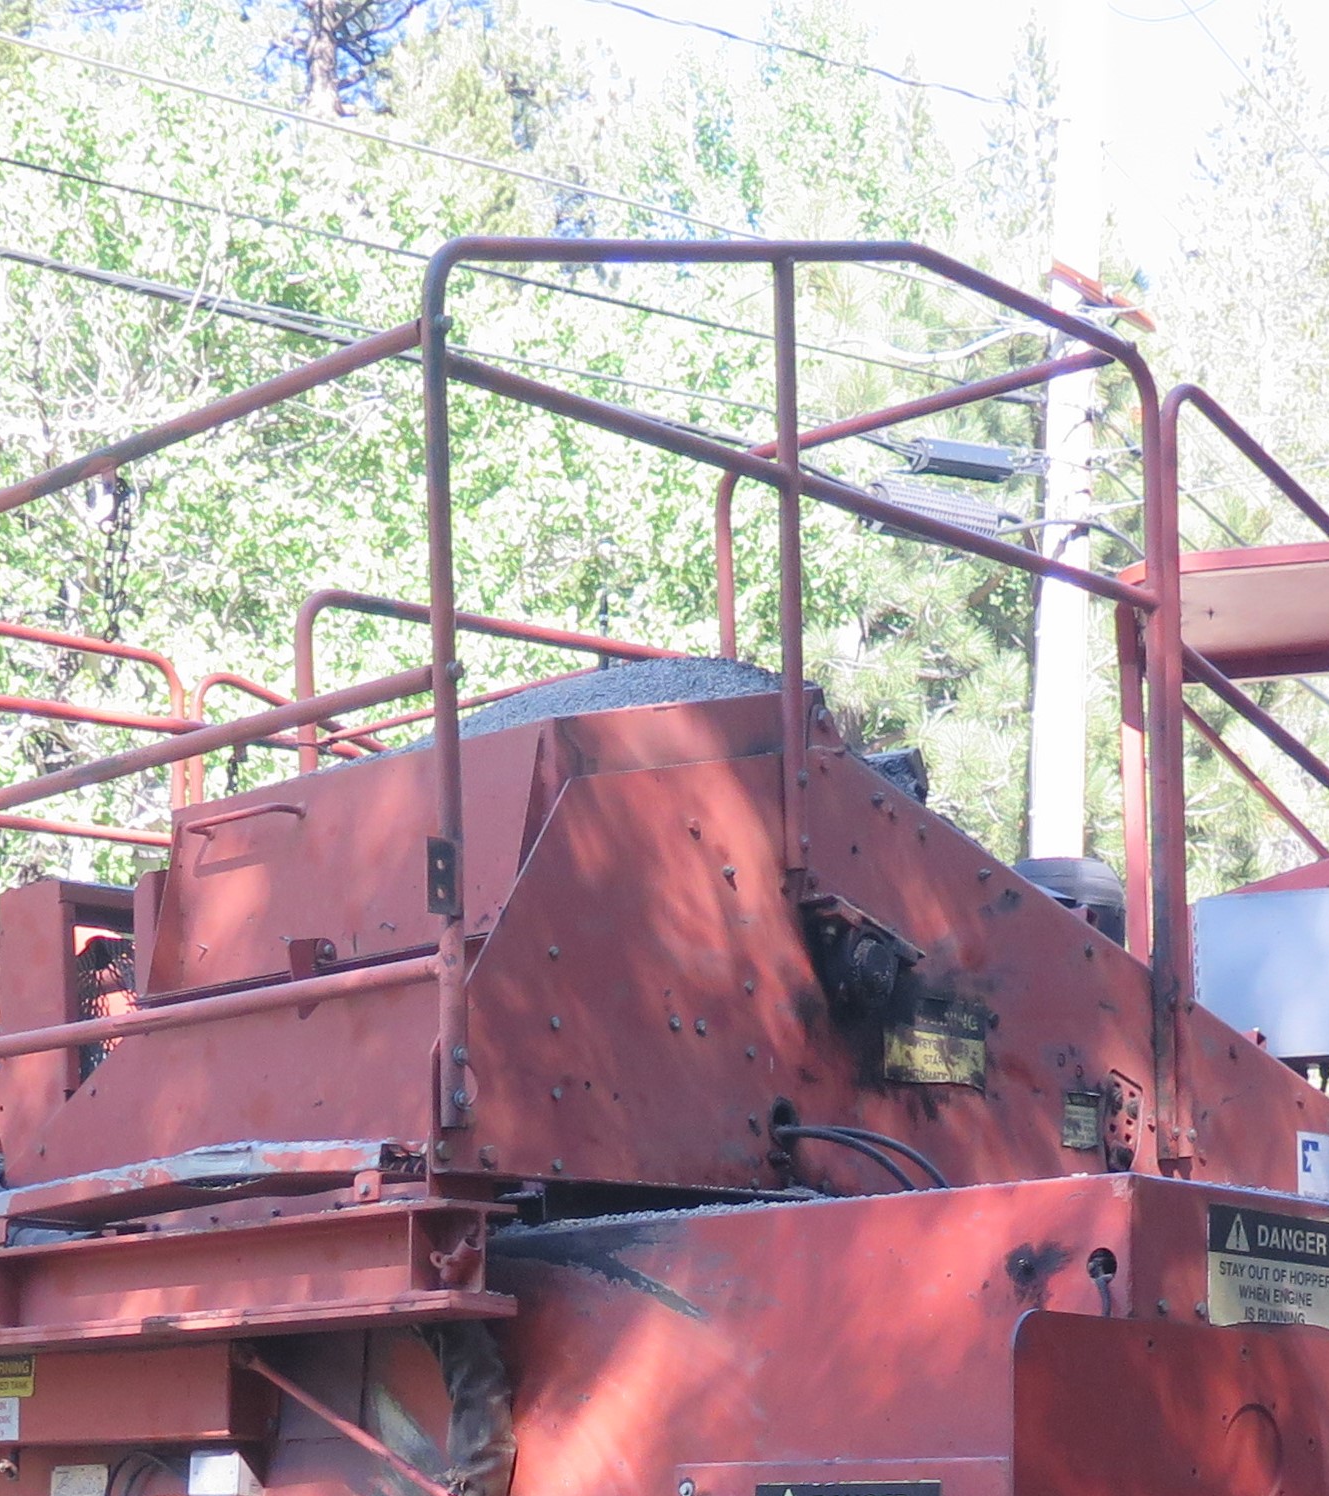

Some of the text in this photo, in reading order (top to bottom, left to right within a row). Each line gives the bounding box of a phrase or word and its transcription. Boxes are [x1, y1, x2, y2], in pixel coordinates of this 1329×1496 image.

[1257, 1224, 1328, 1256] DANGER
[1219, 1260, 1246, 1278] STAY
[1248, 1264, 1269, 1280] OUT
[1272, 1268, 1287, 1283] OF
[1239, 1284, 1313, 1307] WHEN ENGINE
[1244, 1306, 1305, 1324] IS RUNNING
